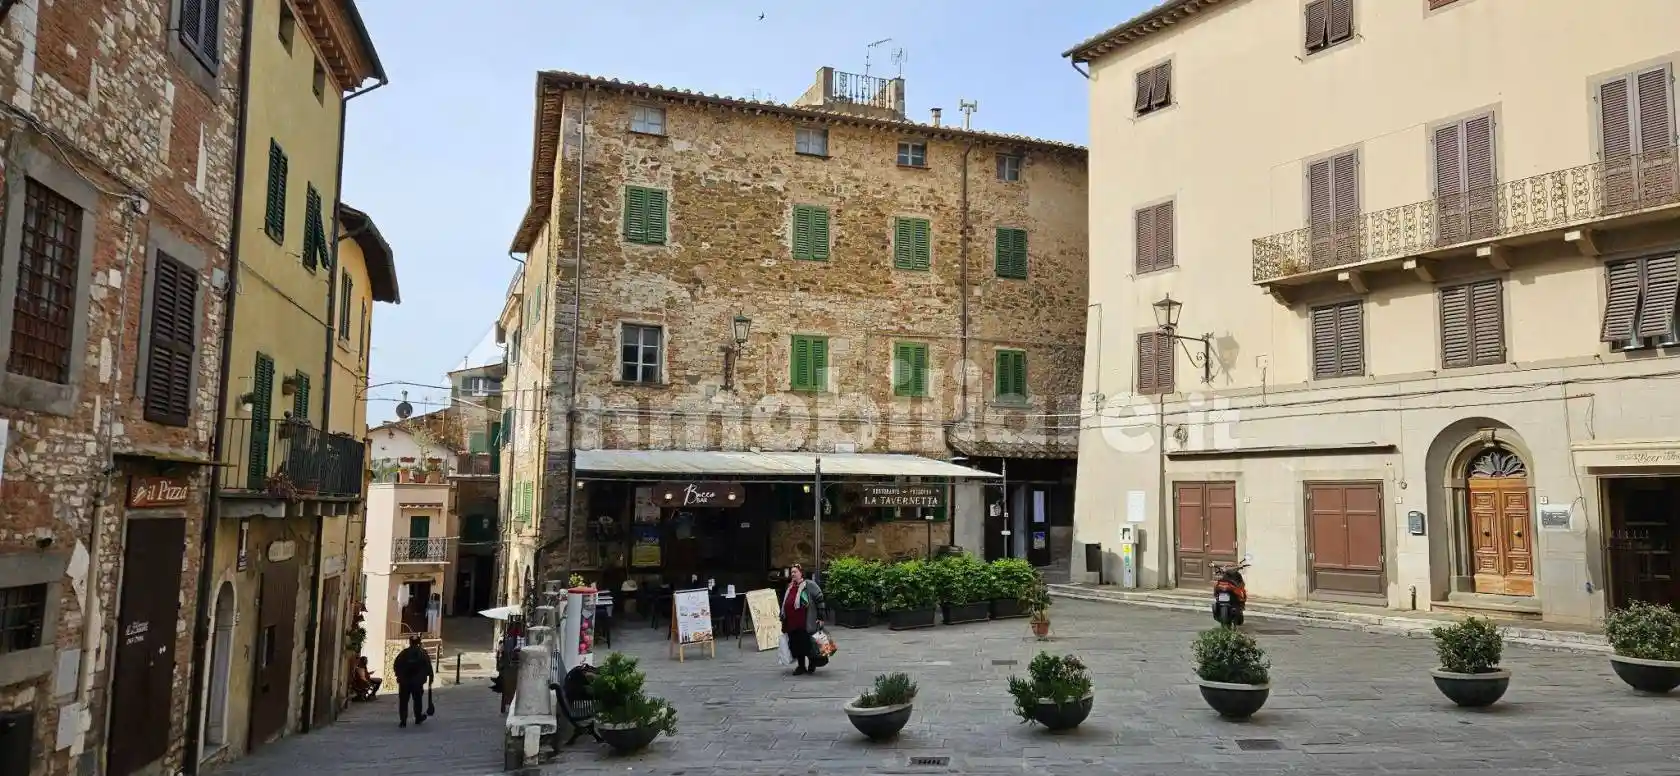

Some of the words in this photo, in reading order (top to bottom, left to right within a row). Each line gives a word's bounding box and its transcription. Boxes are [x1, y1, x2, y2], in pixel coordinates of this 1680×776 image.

[156, 480, 188, 501] Pizza
[864, 496, 877, 505] LA
[880, 496, 938, 505] TAVERNETTA
